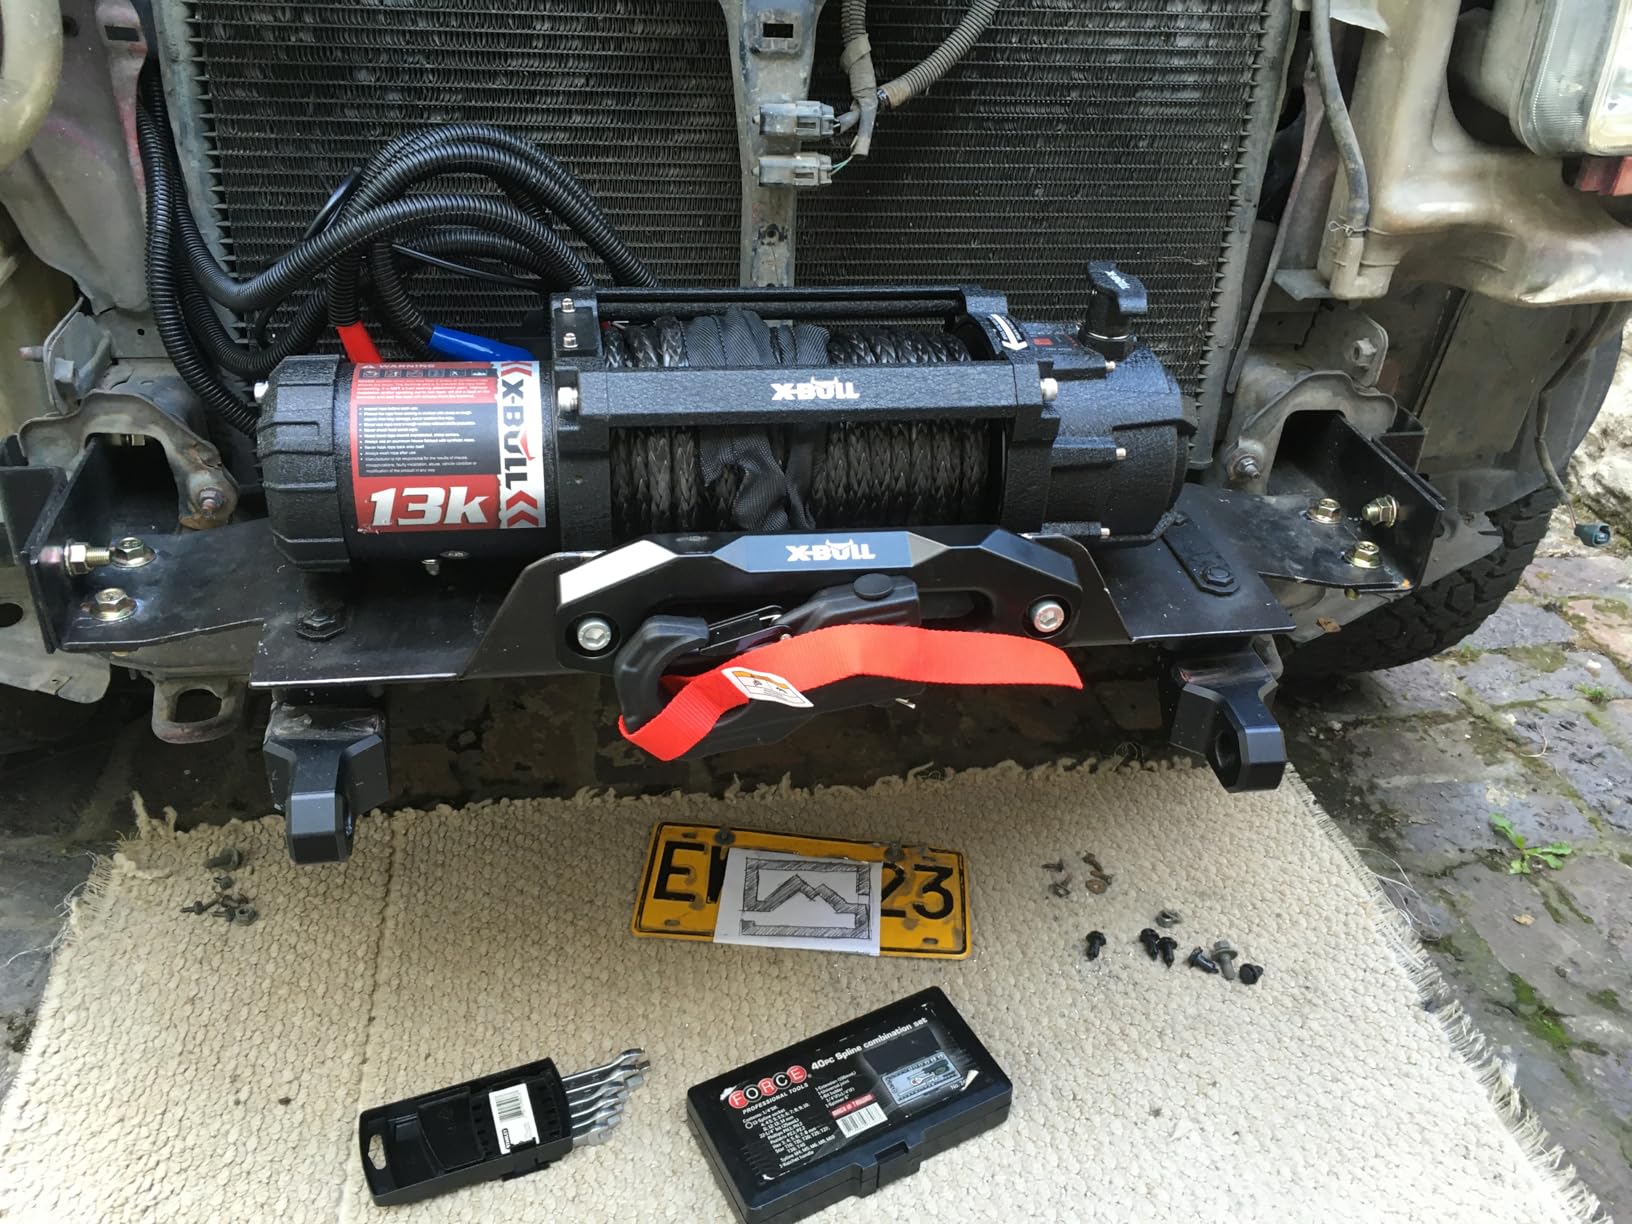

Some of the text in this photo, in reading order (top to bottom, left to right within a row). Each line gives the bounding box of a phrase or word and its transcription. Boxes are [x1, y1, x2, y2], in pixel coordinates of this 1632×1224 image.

[770, 376, 860, 400] X-BULL
[502, 378, 533, 490] X-BULL
[370, 486, 490, 527] 13k
[785, 538, 876, 562] X-BULL
[811, 1017, 928, 1071] 40pc Spline combination set
[730, 1066, 806, 1108] FORCE
[742, 1082, 809, 1115] PROFESSIONAL TOOLS
